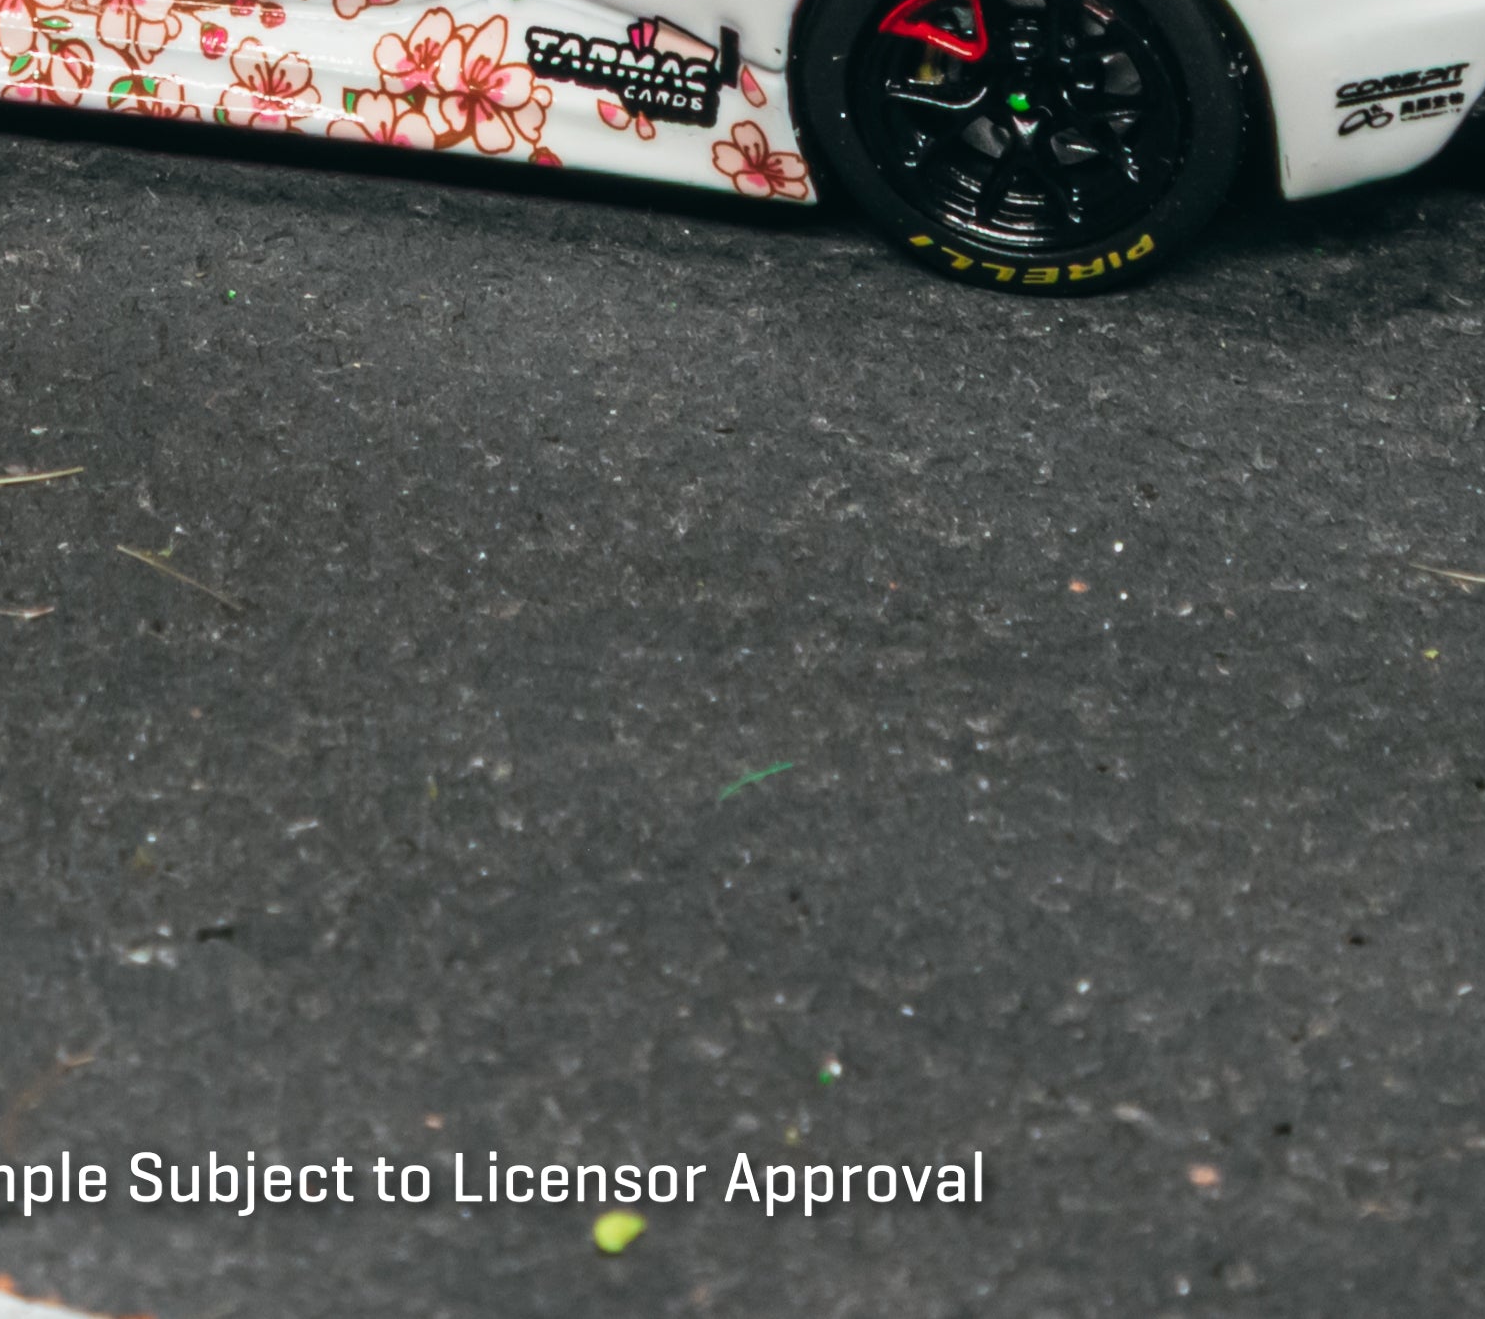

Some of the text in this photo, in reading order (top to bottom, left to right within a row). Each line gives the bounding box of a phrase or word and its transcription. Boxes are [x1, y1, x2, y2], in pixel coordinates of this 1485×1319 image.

[532, 32, 708, 92] TARMAC
[624, 85, 703, 111] CARDS
[909, 234, 1155, 283] PIRELLI
